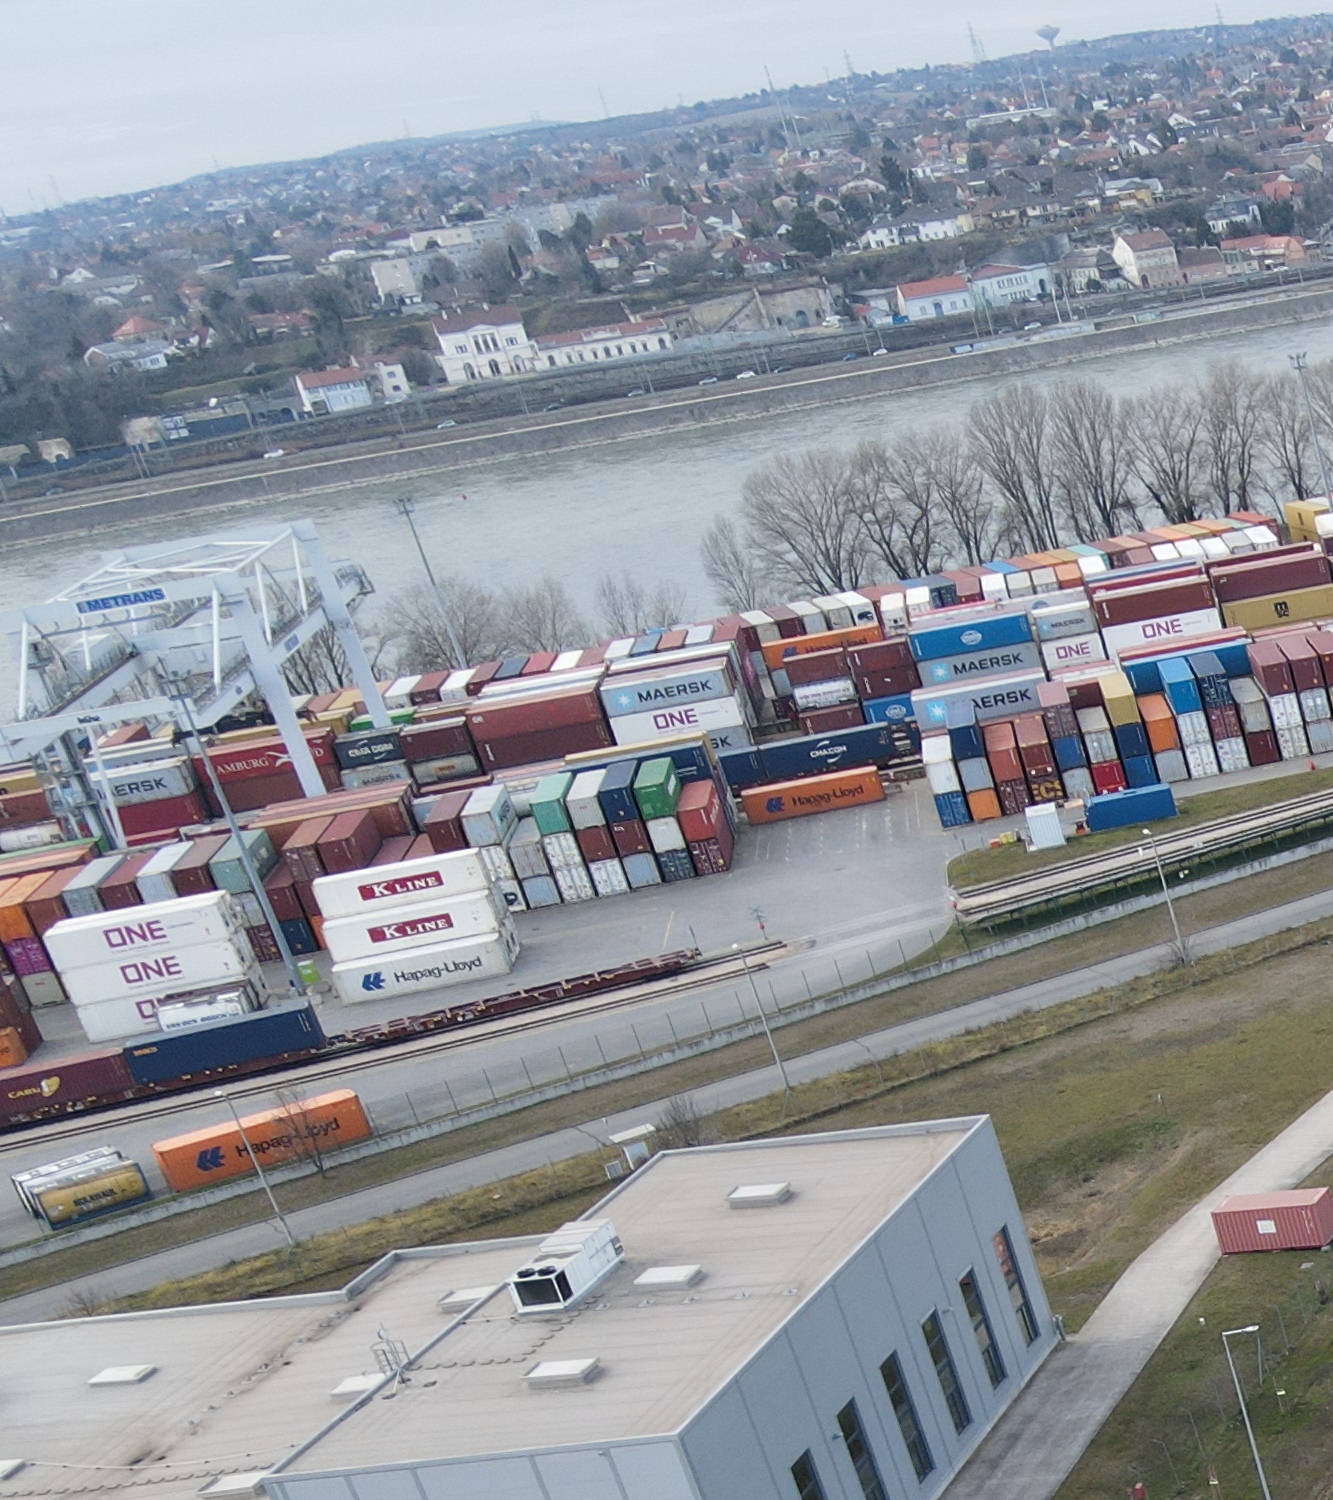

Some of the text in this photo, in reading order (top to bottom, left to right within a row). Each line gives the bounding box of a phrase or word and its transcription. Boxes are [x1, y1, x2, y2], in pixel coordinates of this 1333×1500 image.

[87, 588, 165, 610] METRANS
[1142, 618, 1183, 639] ONE
[1056, 642, 1091, 659] ONE
[953, 652, 1024, 675] MAERSK
[637, 680, 713, 703] MAERSK
[653, 708, 699, 730] ONE
[207, 756, 270, 776] AMBURG
[791, 785, 864, 806] Hapag-Lloyd
[395, 876, 440, 893] LINE
[103, 920, 168, 949] ONE
[405, 918, 448, 934] LINE
[119, 955, 183, 984] ONE
[393, 956, 483, 983] Hapag-Lloyd
